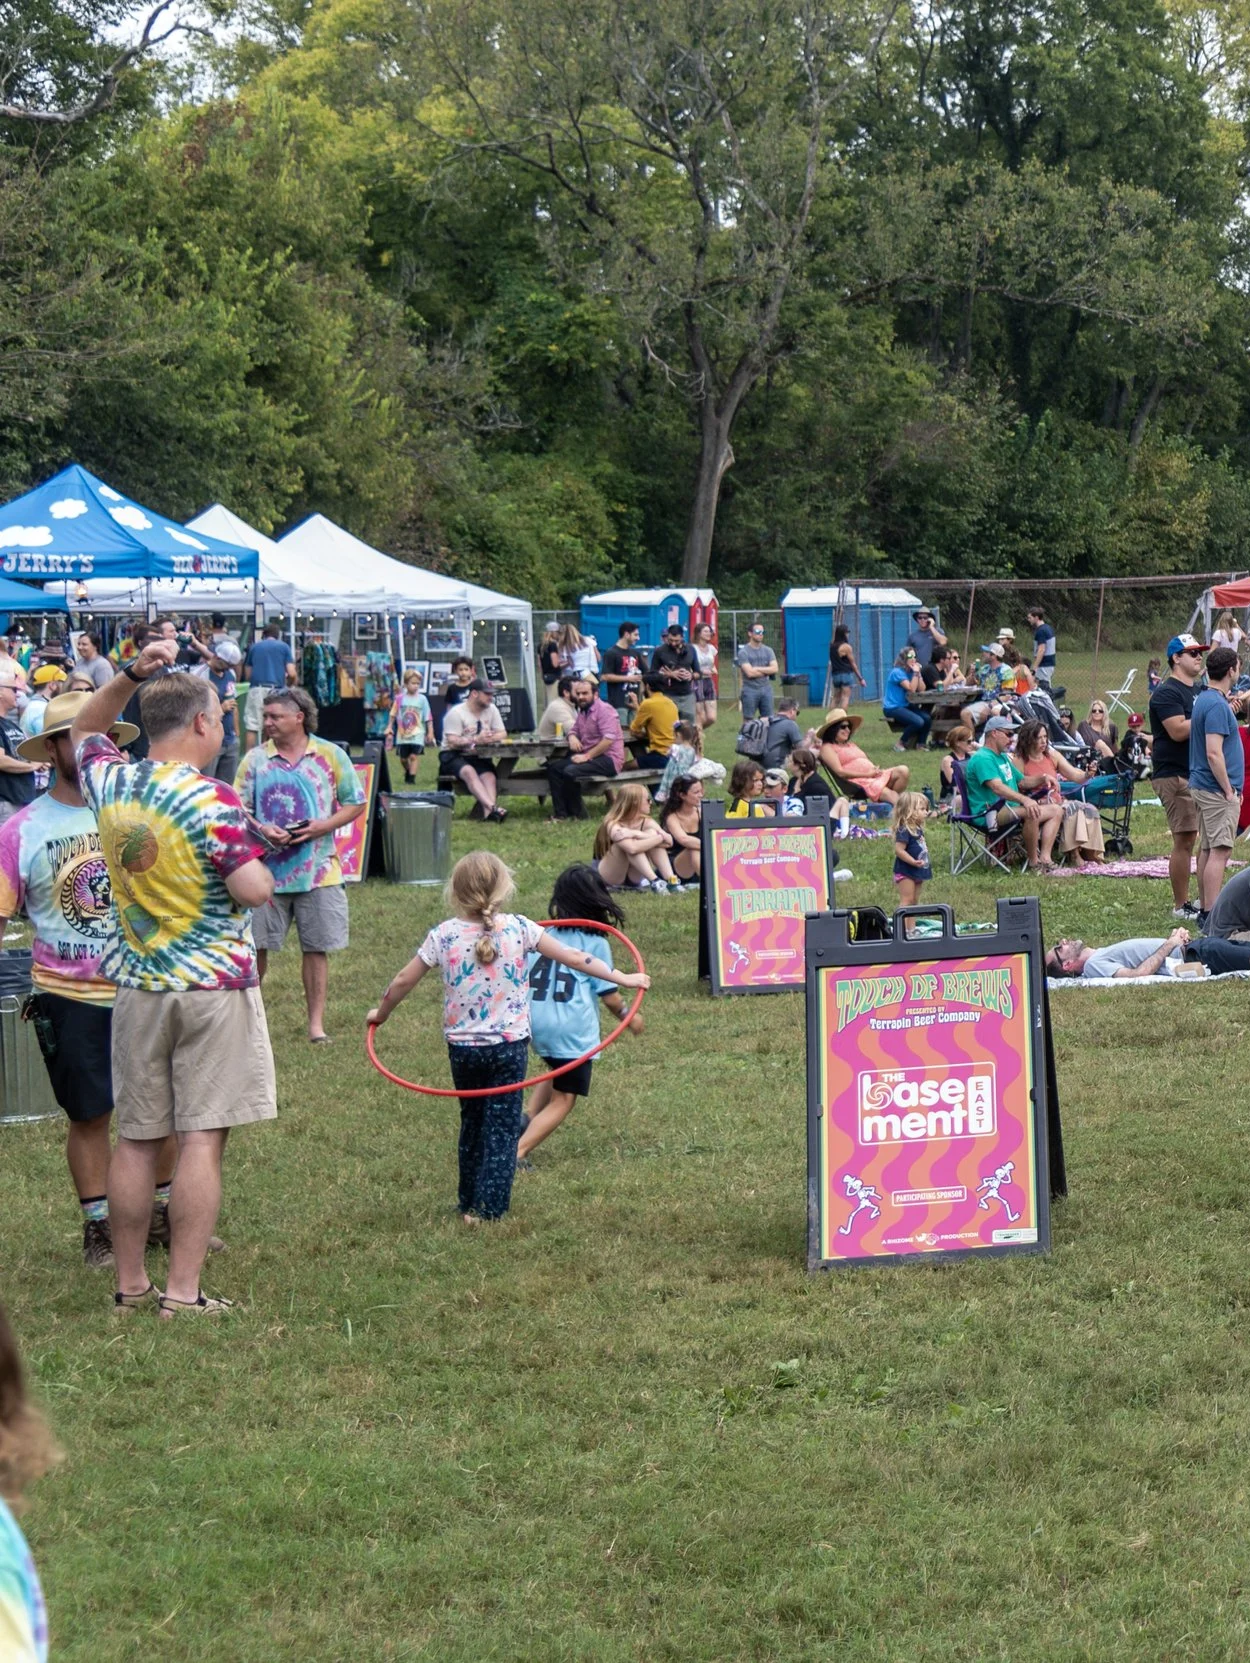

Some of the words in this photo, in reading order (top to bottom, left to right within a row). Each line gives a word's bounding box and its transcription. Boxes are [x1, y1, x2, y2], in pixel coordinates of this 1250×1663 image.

[3, 552, 94, 574] JERRY'S
[170, 555, 194, 574] BEN
[201, 553, 239, 575] JERRY'S
[778, 834, 818, 862] BREWS
[726, 888, 817, 924] TERRAPIN
[74, 943, 88, 960] OCT
[89, 943, 95, 960] 2
[835, 976, 907, 1033] TOUCH
[909, 974, 939, 1001] OF
[941, 968, 1014, 1019] BREWS
[870, 1017, 912, 1030] Terrapin
[914, 1014, 936, 1027] Beer
[938, 1011, 981, 1023] Company
[882, 1072, 906, 1082] THE
[862, 1074, 965, 1110] base
[862, 1103, 968, 1142] ment
[896, 1191, 936, 1203] PARTICIPATING
[936, 1189, 963, 1200] SPONSOR
[940, 1232, 979, 1241] PRODUCTION
